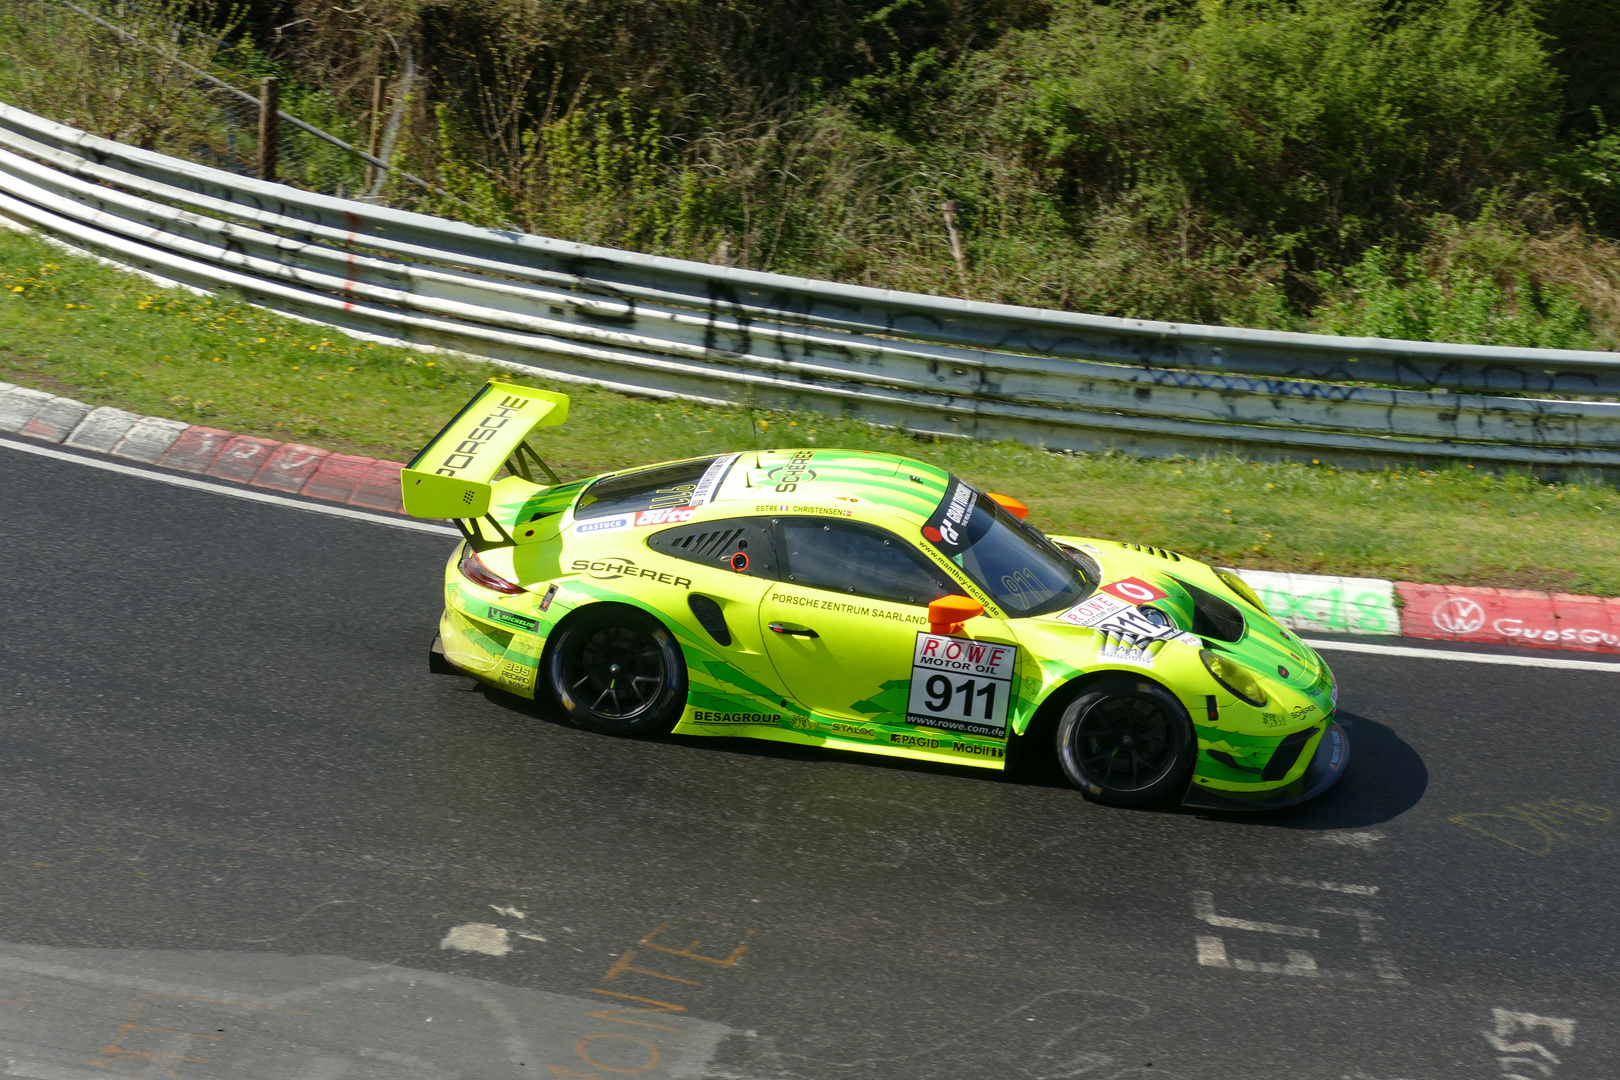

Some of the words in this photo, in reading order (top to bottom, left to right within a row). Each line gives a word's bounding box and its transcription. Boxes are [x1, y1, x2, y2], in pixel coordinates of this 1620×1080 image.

[636, 508, 697, 526] auto
[793, 505, 843, 516] CHRISTENSEN
[582, 520, 622, 532] BASTUCK
[571, 560, 692, 590] SCHERER
[919, 540, 999, 617] www.manthey-racing.de
[1001, 568, 1053, 609] 911
[772, 593, 819, 608] PORSCHE
[821, 600, 870, 616] ZENTRUM
[872, 608, 927, 625] SAARLAND
[502, 615, 535, 627] MICHELIN
[921, 638, 1006, 667] ROWE
[920, 656, 970, 670] MOTOR
[975, 664, 997, 675] OIL
[924, 674, 997, 720] 911
[694, 711, 781, 723] BESAGROUP
[1291, 705, 1316, 719] SCHERER
[832, 723, 875, 736] STALOC
[907, 714, 1005, 737] www.rowe.com.de
[902, 735, 939, 748] PAGID
[953, 742, 989, 756] Mobil
